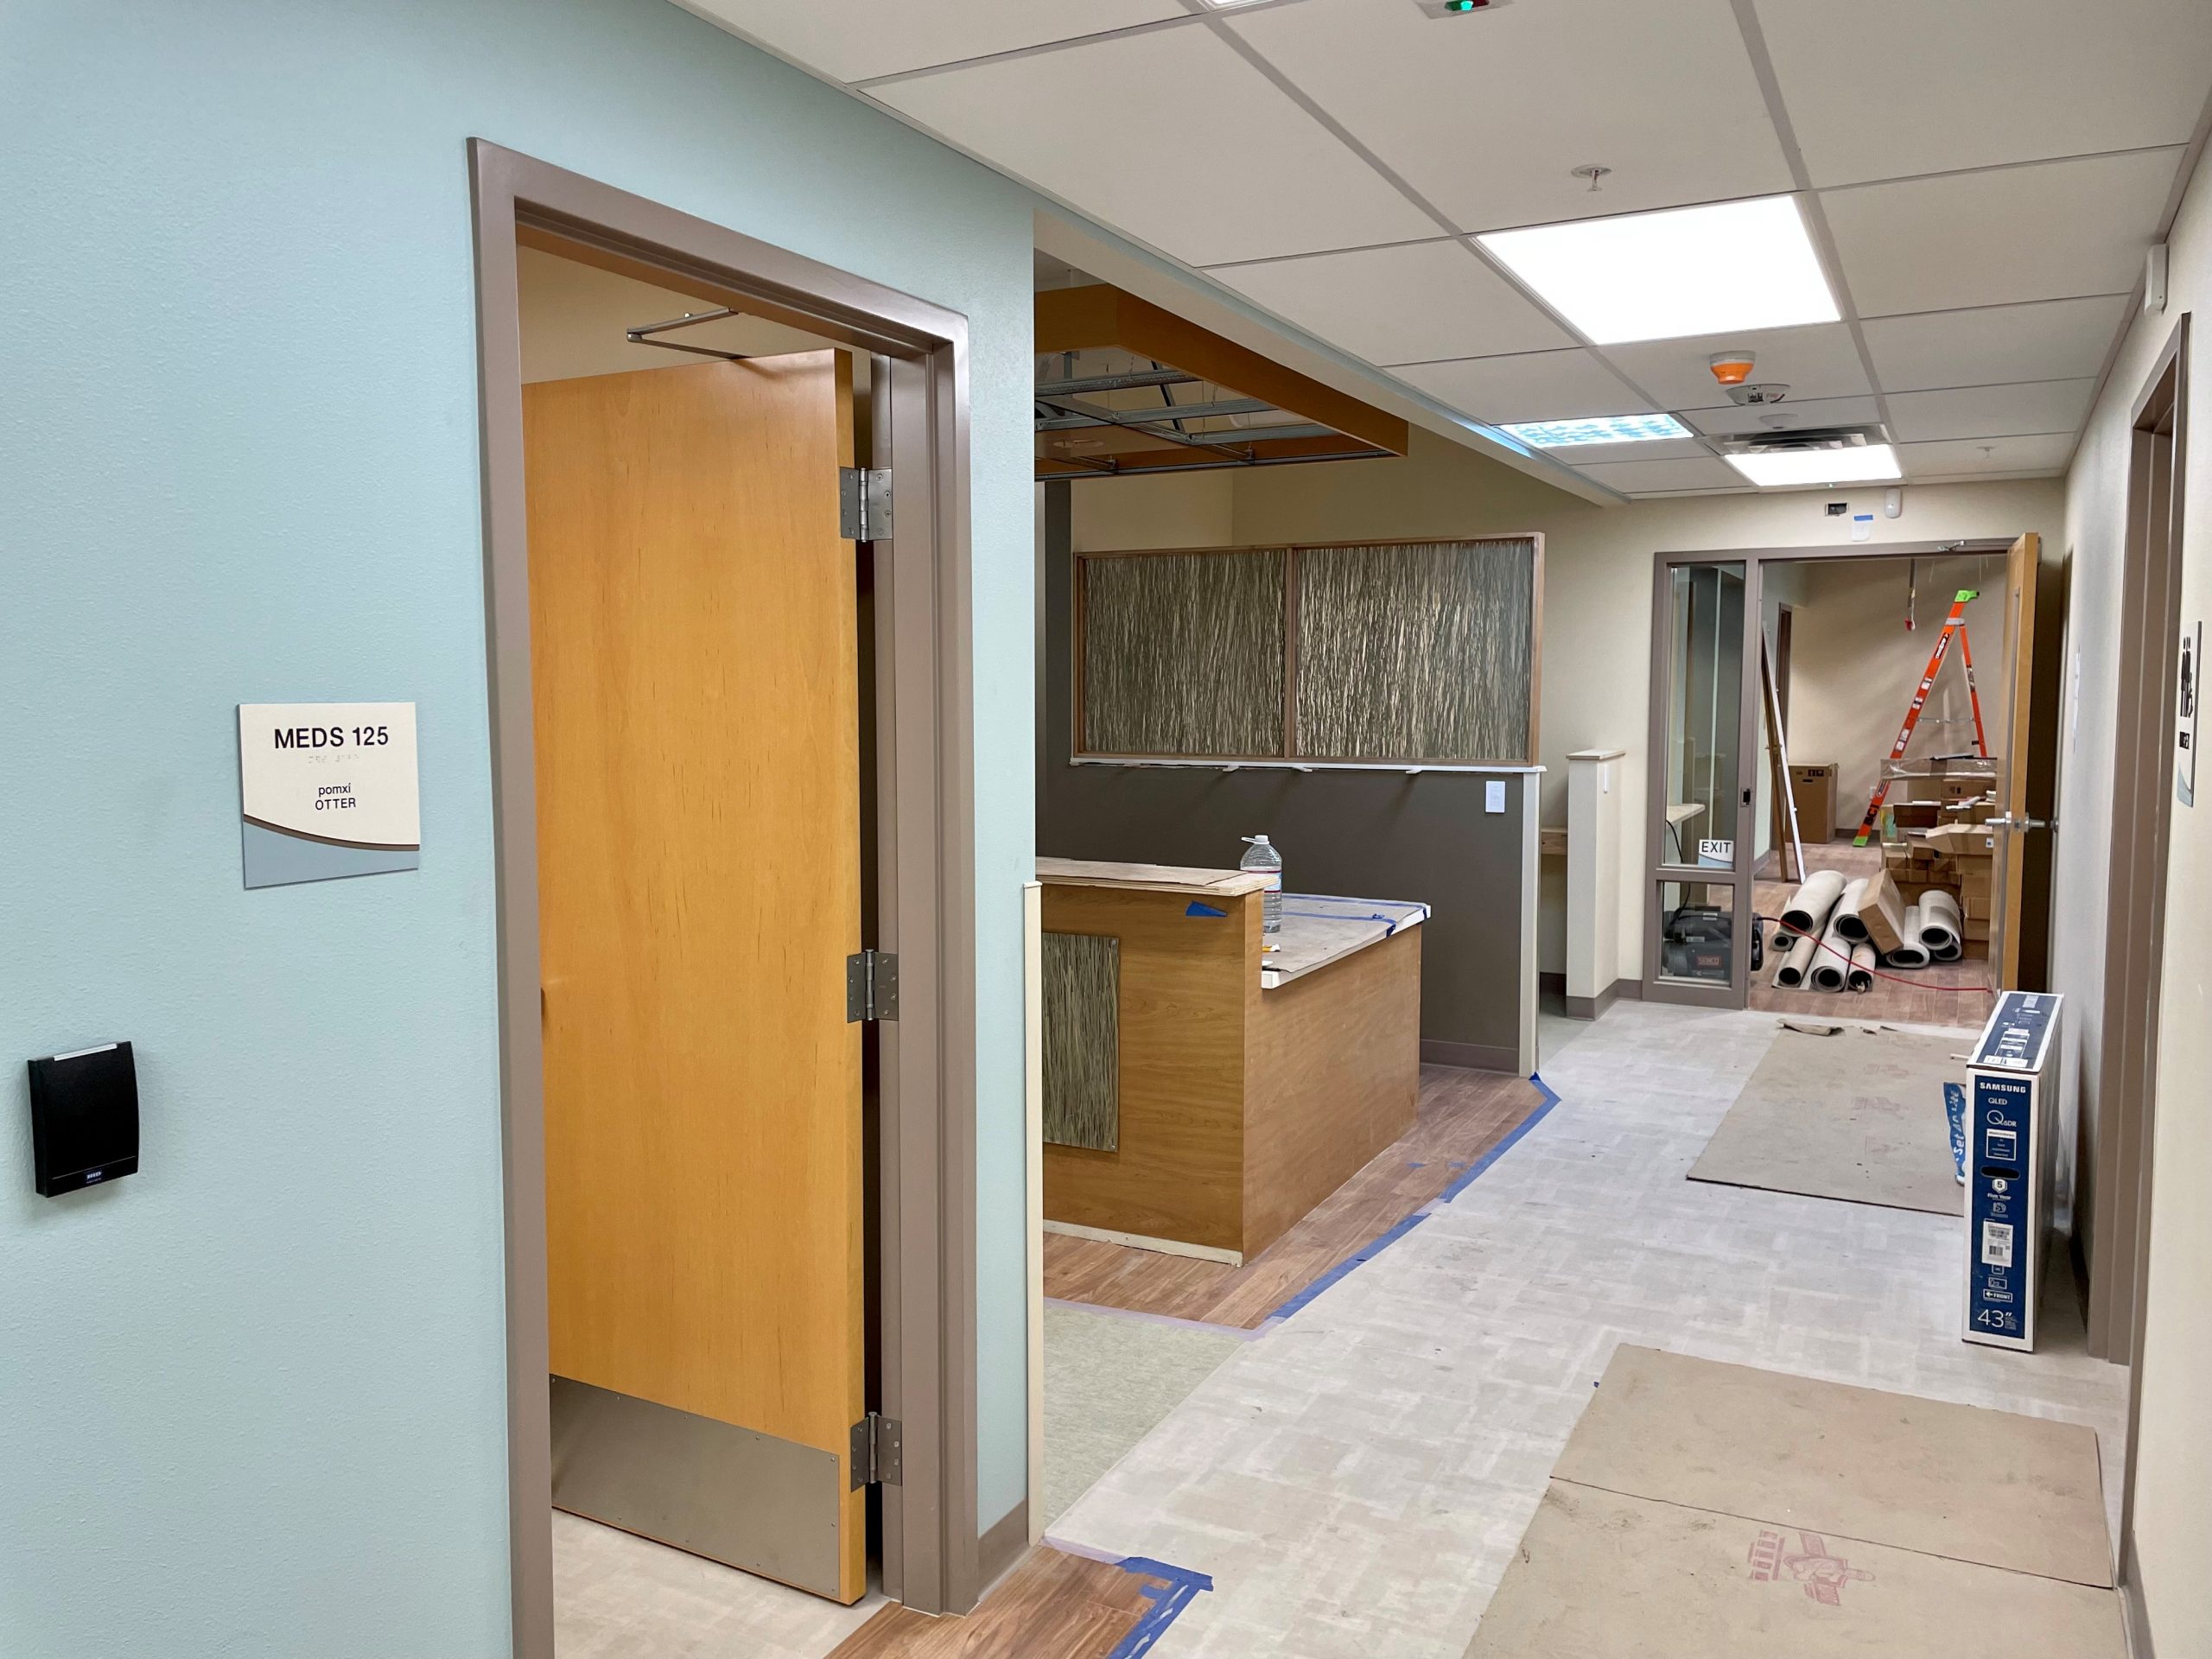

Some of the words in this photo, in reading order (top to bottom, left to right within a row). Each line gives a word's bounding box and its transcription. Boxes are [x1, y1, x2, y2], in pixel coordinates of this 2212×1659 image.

[274, 727, 344, 749] MEDS
[352, 726, 389, 747] 125
[318, 783, 352, 797] pomxí
[315, 798, 356, 810] OTTER
[1701, 841, 1732, 854] EXIT
[1980, 1082, 2026, 1093] SAMSUNG
[1953, 1134, 1965, 1155] Set
